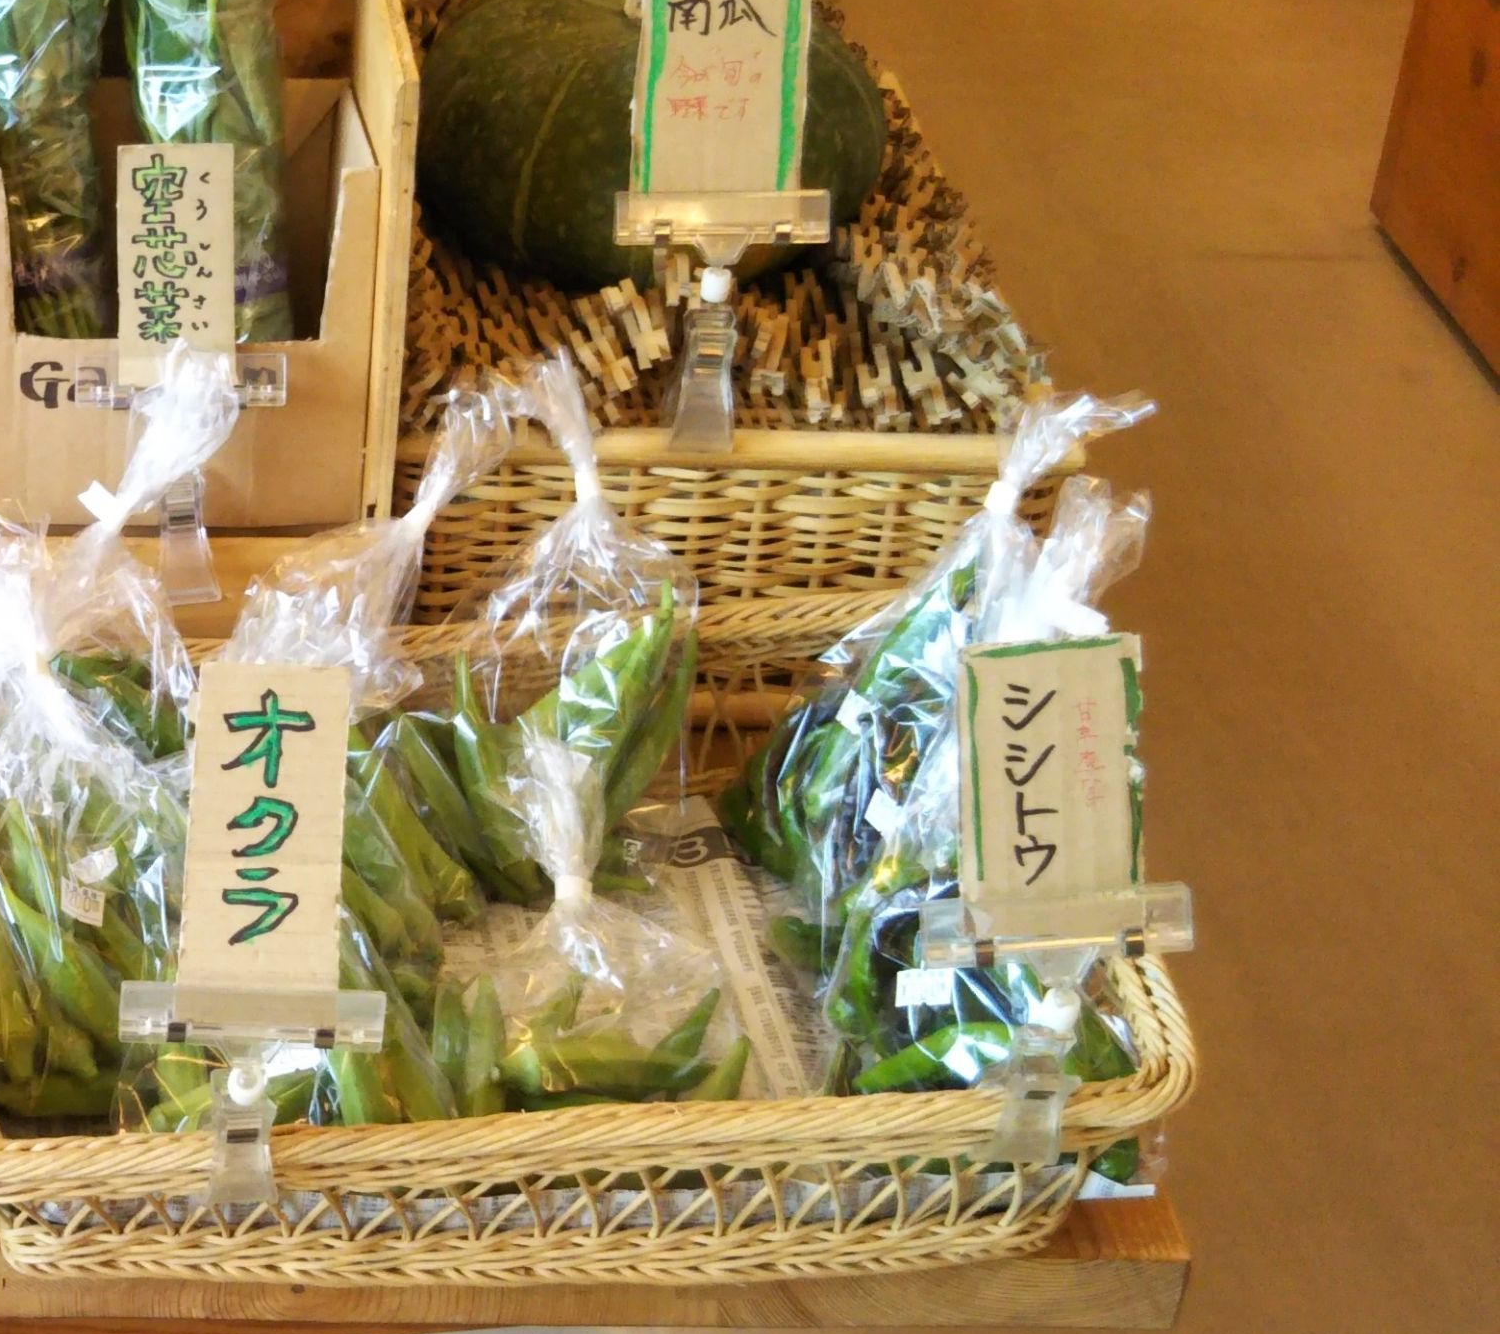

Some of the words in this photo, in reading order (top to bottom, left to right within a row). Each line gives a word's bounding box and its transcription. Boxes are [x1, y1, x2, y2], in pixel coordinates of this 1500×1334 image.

[132, 153, 198, 344] 空芯菜
[191, 171, 213, 332] くうしんさい
[220, 687, 316, 947] オクラ
[1001, 682, 1060, 887] シシトウ
